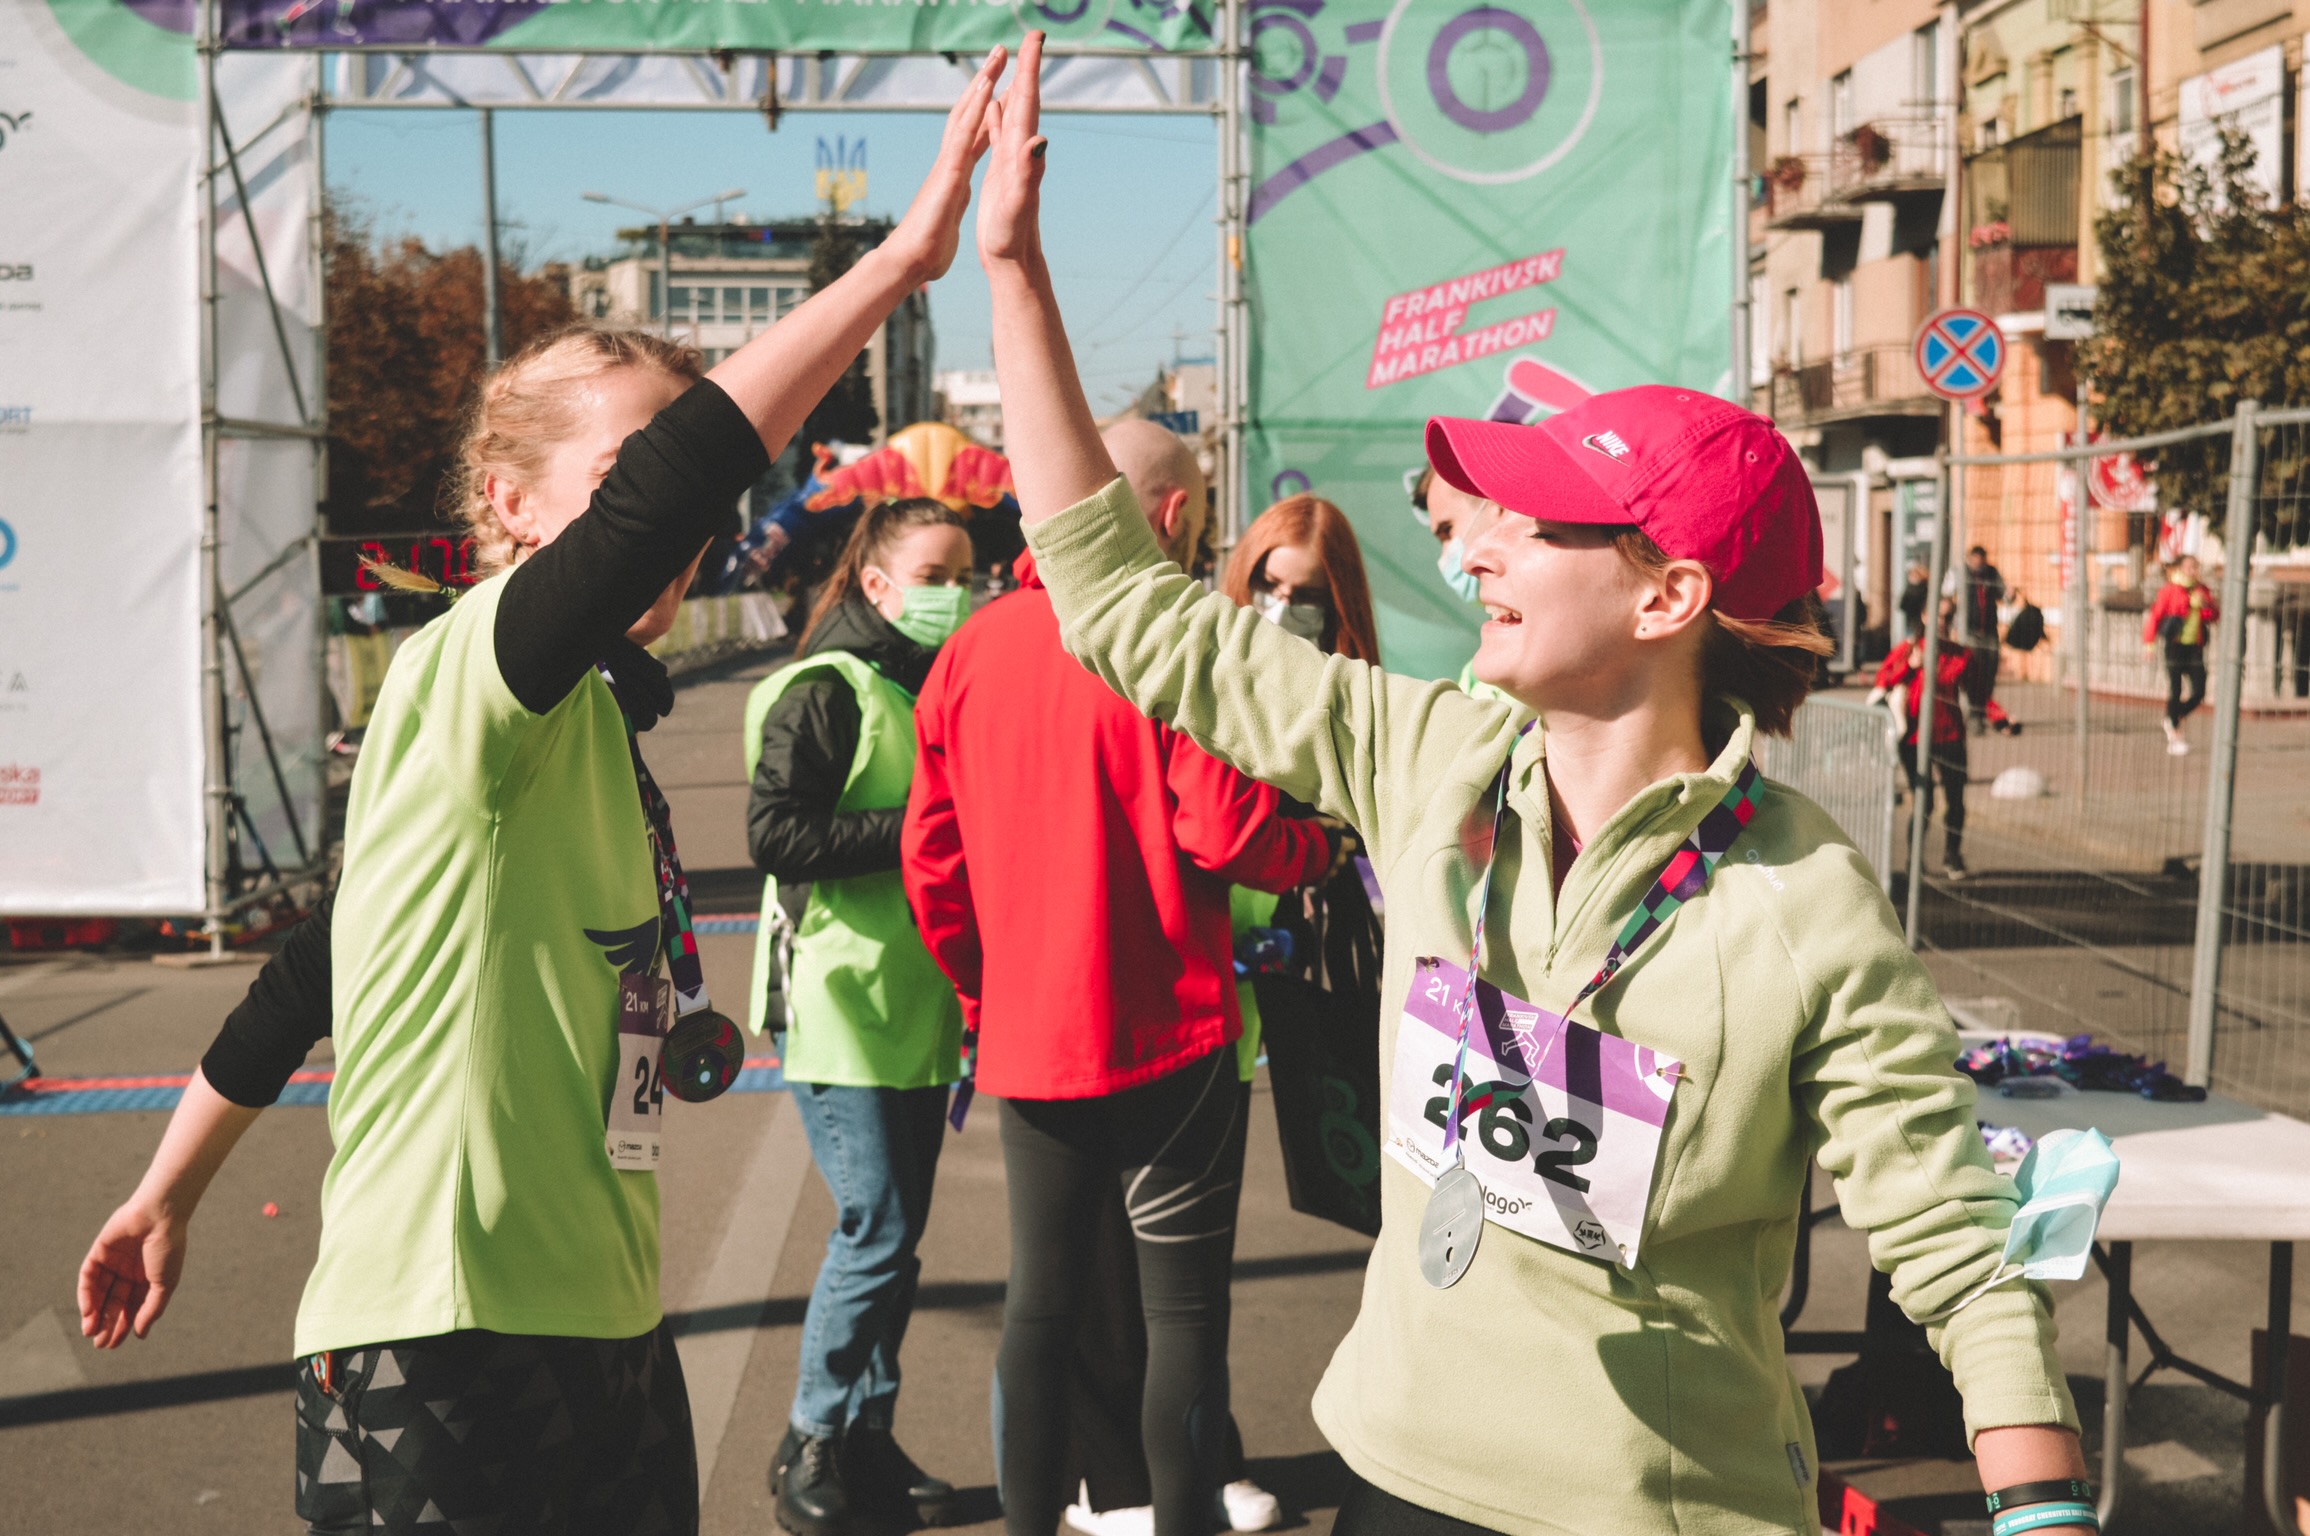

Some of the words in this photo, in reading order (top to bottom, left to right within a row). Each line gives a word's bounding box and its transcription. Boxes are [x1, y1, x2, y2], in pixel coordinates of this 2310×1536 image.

[1385, 253, 1560, 325] FRANKIVSK
[1370, 312, 1554, 386] MARATHON
[1378, 308, 1463, 354] HALF
[1596, 430, 1630, 458] NIKE
[625, 991, 638, 1012] 21
[1425, 976, 1451, 1007] 21
[1424, 1062, 1598, 1194] 262
[1483, 1185, 1520, 1215] lago
